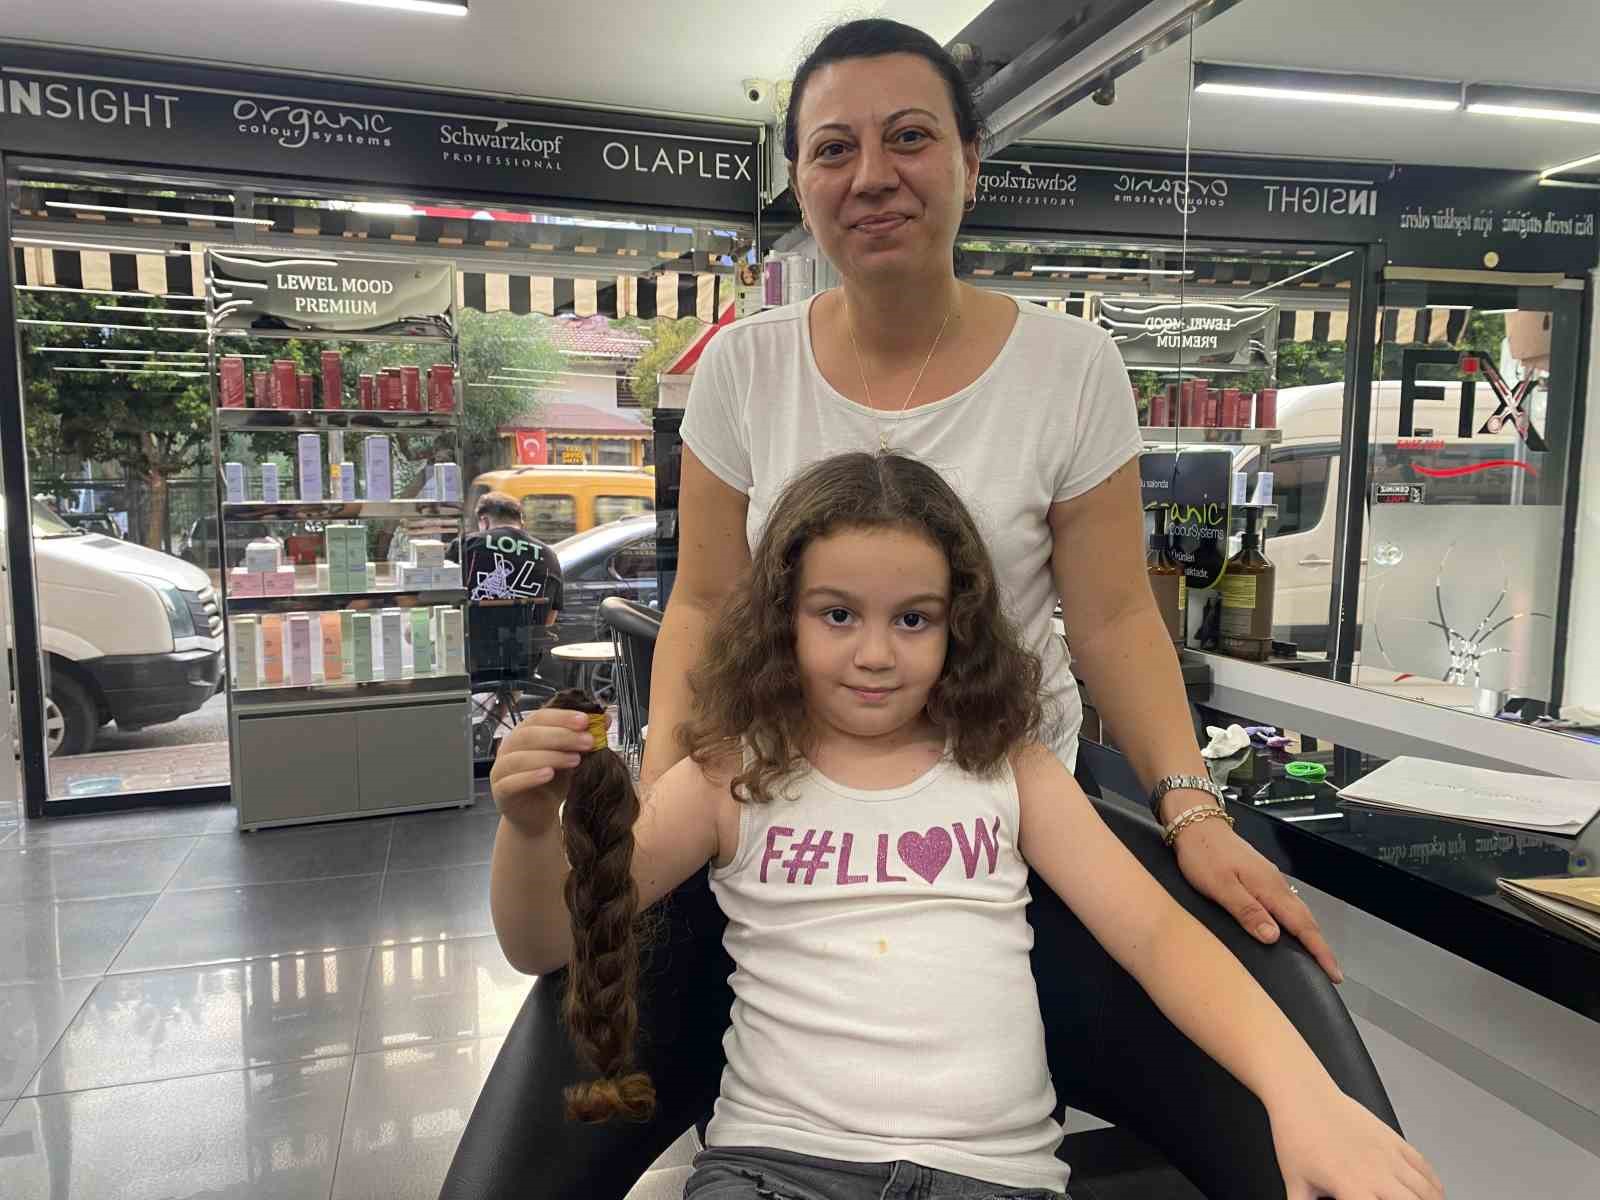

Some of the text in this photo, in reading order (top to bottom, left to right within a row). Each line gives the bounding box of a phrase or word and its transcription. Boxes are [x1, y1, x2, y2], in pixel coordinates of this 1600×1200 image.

[233, 99, 392, 148] organic
[440, 125, 563, 155] Schwarzkopf
[443, 152, 562, 170] PROFESSIONAL
[602, 142, 751, 181] OLAPLEX
[276, 274, 393, 294] LEWEL MOOD
[295, 297, 377, 314] PREMIUM
